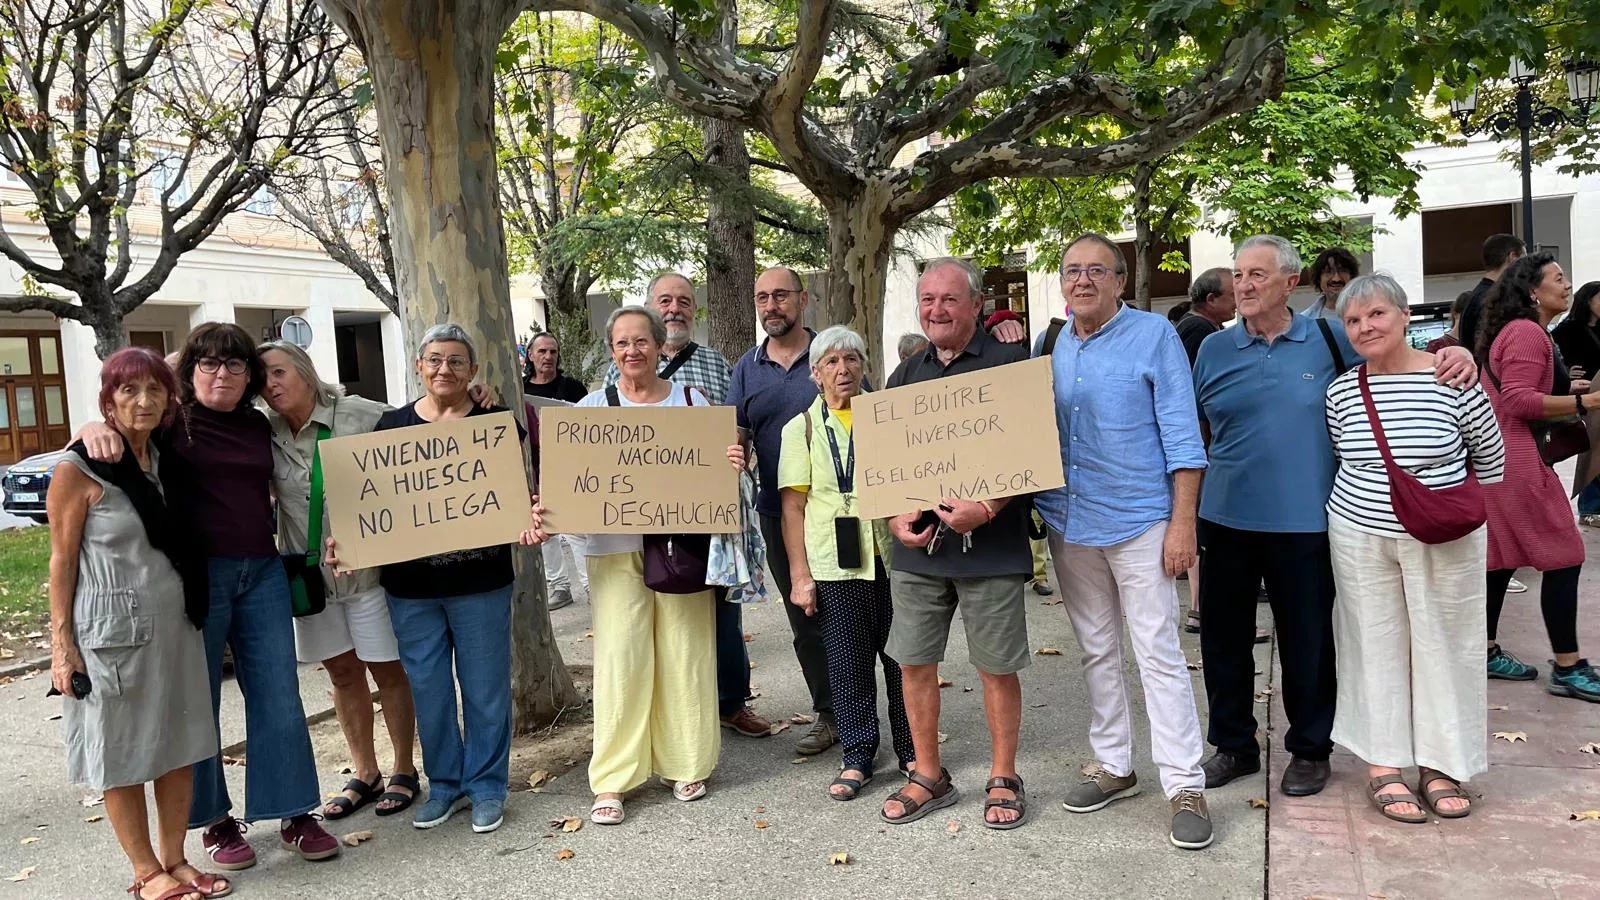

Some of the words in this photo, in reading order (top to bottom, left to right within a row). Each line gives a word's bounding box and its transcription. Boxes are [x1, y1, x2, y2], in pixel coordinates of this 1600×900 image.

[873, 400, 903, 425] EL
[352, 435, 460, 473] VIVIENDA
[472, 425, 507, 450] 47
[360, 478, 379, 501] A
[393, 459, 487, 495] HUESCA
[574, 466, 600, 494] NO
[608, 473, 634, 494] ES
[864, 467, 885, 487] ES
[890, 467, 909, 483] EL
[913, 452, 956, 479] GRAN
[358, 508, 393, 539] NO
[412, 490, 501, 528] LLEGA
